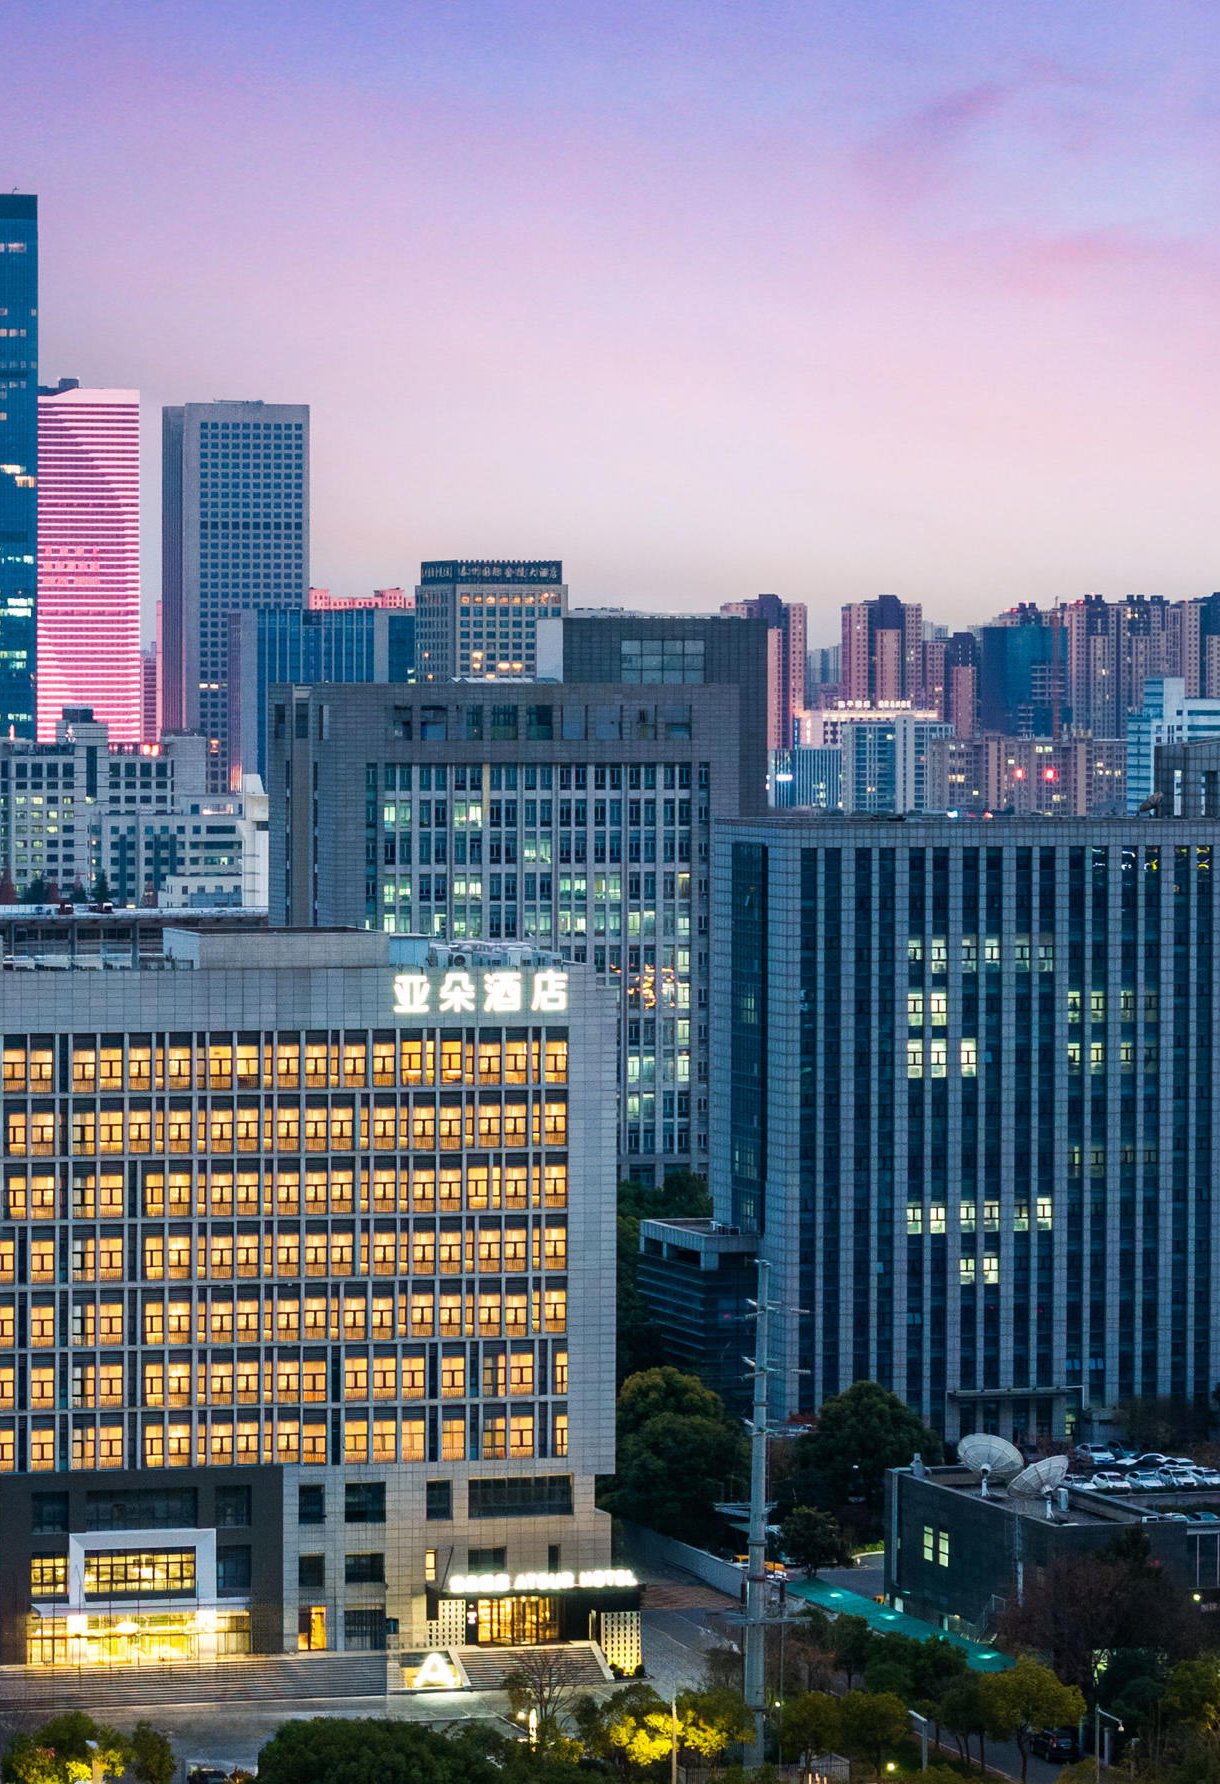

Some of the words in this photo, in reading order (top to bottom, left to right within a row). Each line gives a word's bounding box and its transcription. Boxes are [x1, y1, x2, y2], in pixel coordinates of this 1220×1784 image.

[393, 969, 568, 1013] 亚朵酒店
[579, 1569, 637, 1588] HOTEL
